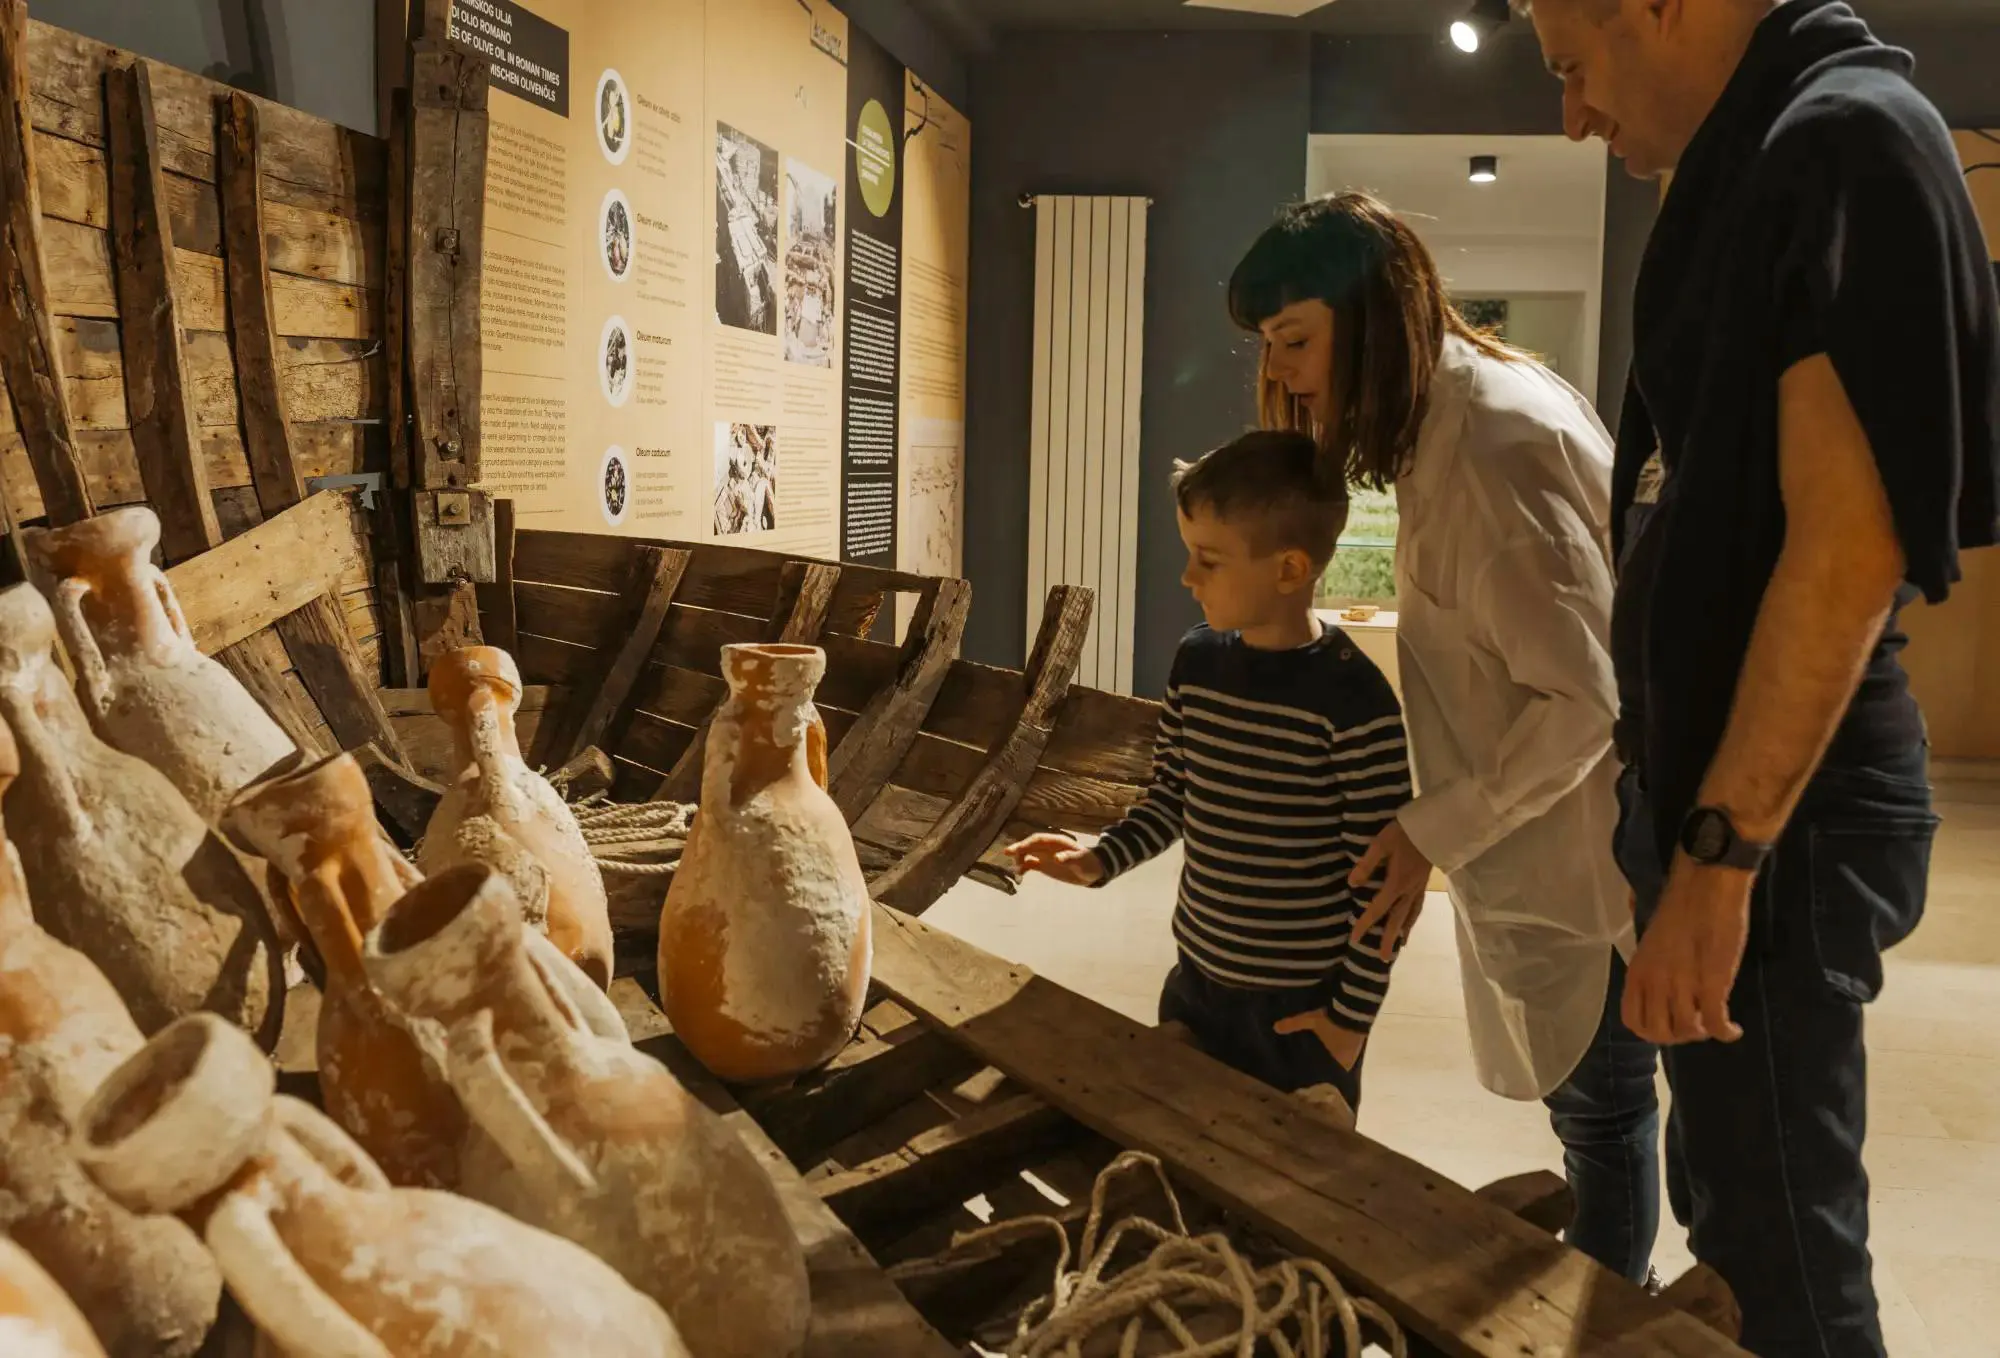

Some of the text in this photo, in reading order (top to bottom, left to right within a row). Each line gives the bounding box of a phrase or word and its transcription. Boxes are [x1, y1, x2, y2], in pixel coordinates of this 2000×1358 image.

[451, 5, 512, 45] DI OLIO ROMANO
[495, 8, 513, 27] ULJA
[461, 30, 472, 45] OF
[473, 35, 494, 56] OLIVE
[495, 46, 507, 62] OIL
[507, 52, 515, 65] IN
[516, 55, 541, 77] ROMAN
[541, 67, 560, 87] TIMES
[520, 77, 556, 102] OLIVENÖLS
[636, 447, 651, 457] Oleum
